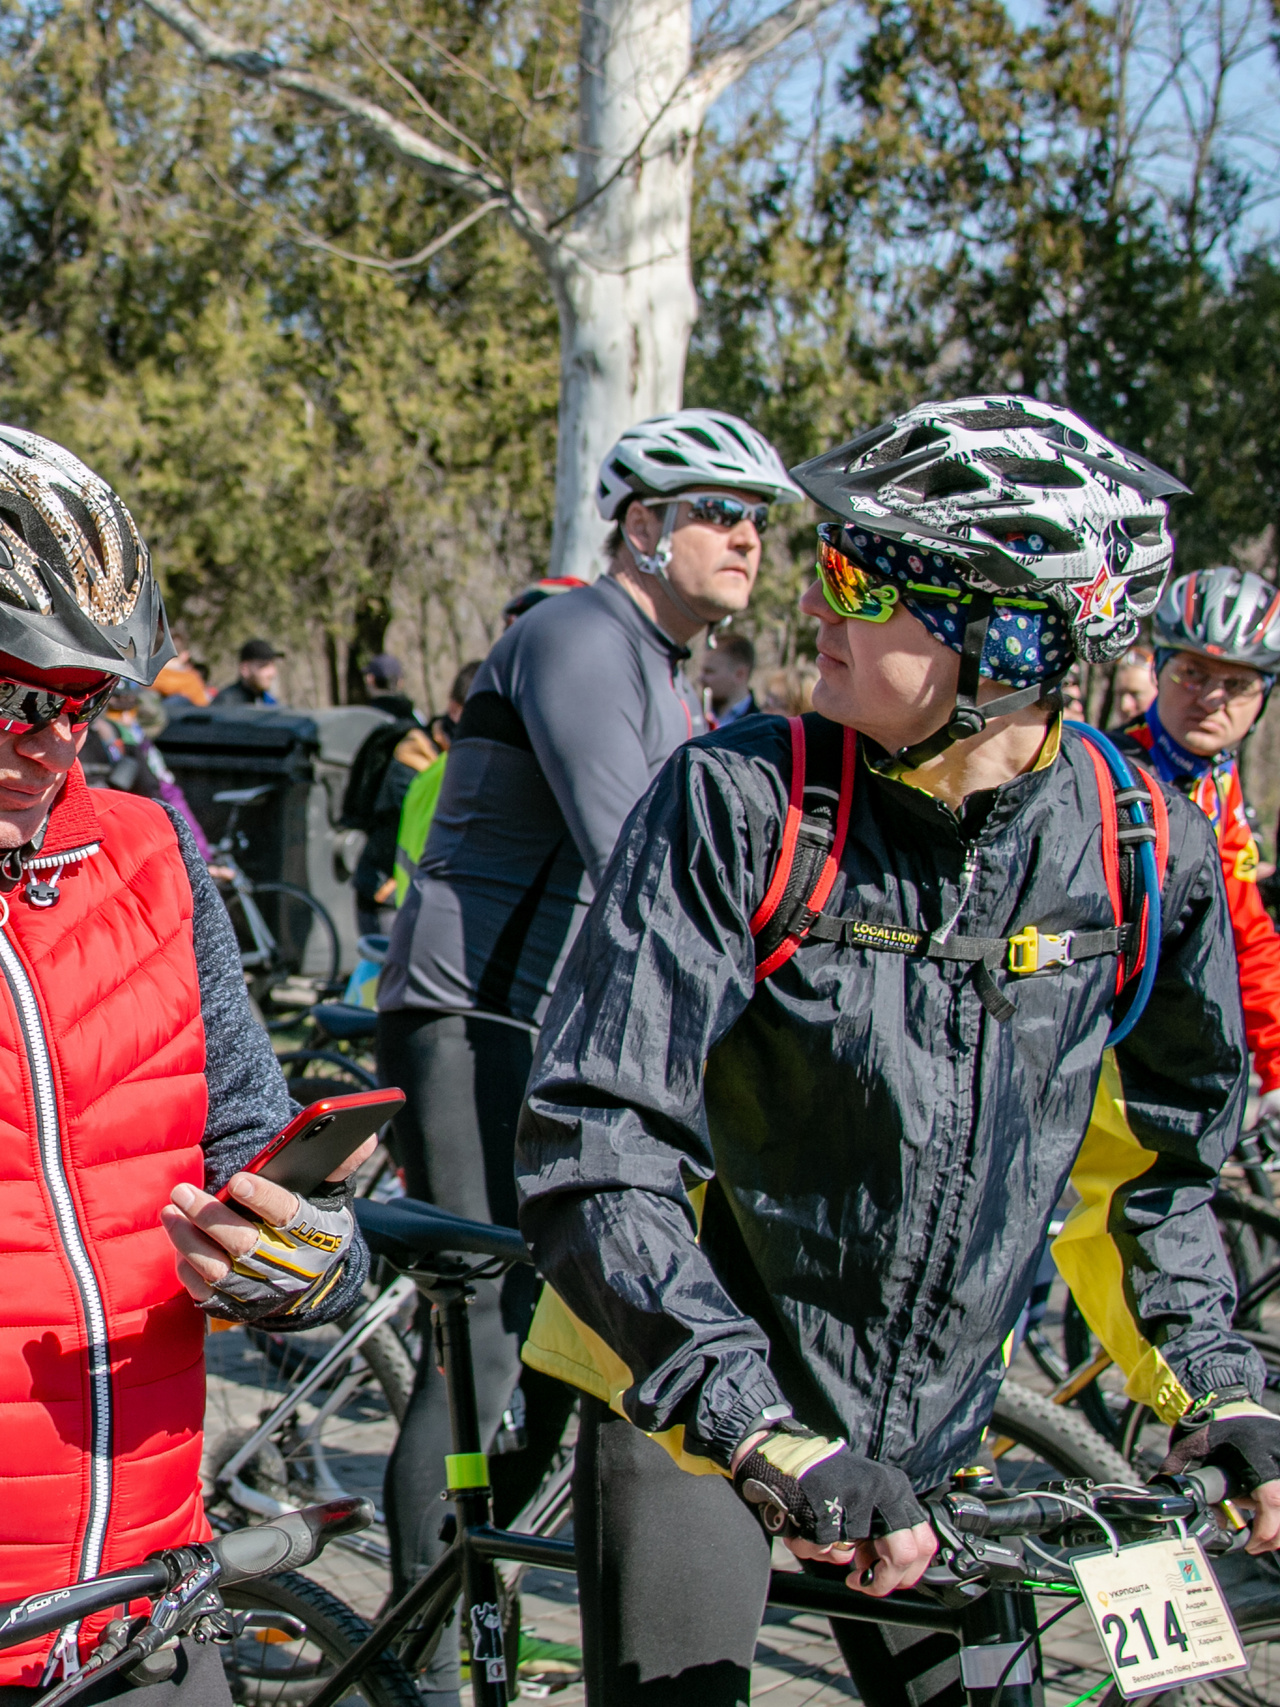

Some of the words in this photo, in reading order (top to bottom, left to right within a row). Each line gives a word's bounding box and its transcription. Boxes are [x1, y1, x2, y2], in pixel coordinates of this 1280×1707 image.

[900, 531, 986, 559] FOX
[287, 1220, 343, 1253] SCOTT
[1109, 1584, 1150, 1598] УКРПОШТА
[1101, 1599, 1189, 1669] 214
